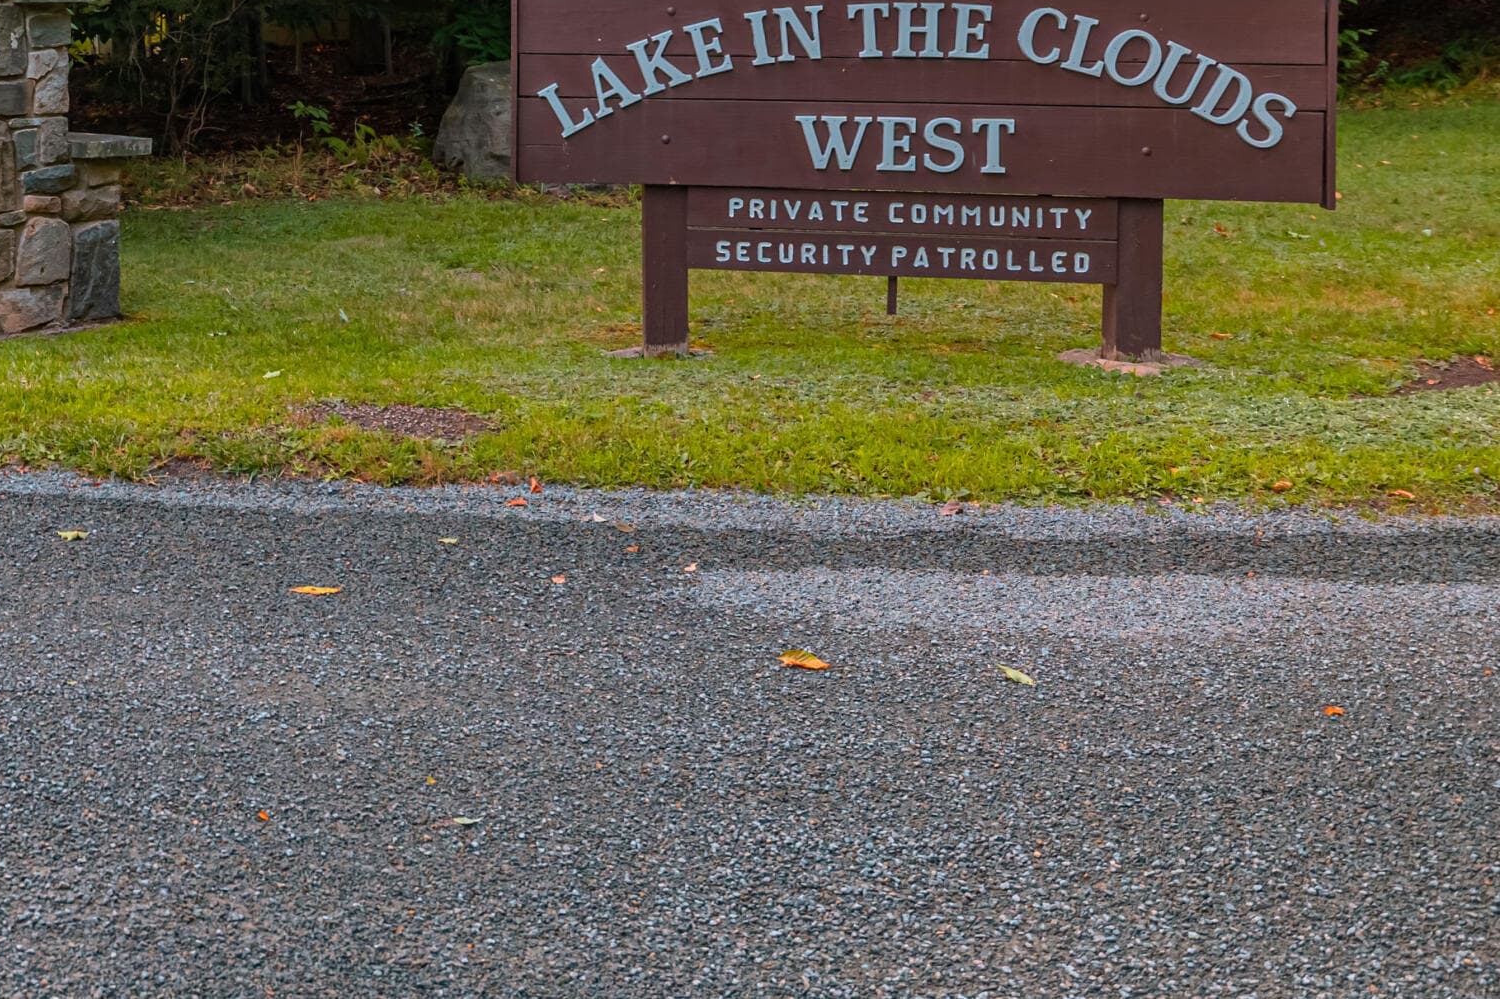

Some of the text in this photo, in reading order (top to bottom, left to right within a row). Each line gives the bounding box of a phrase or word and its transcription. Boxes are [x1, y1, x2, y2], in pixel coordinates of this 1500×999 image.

[537, 2, 1297, 149] LAKE IN THE CLOUDS
[795, 115, 1016, 175] WEST
[728, 197, 1093, 231] PRIVATE COMMUNITY
[715, 240, 1091, 275] SECURITY PATROLLED
